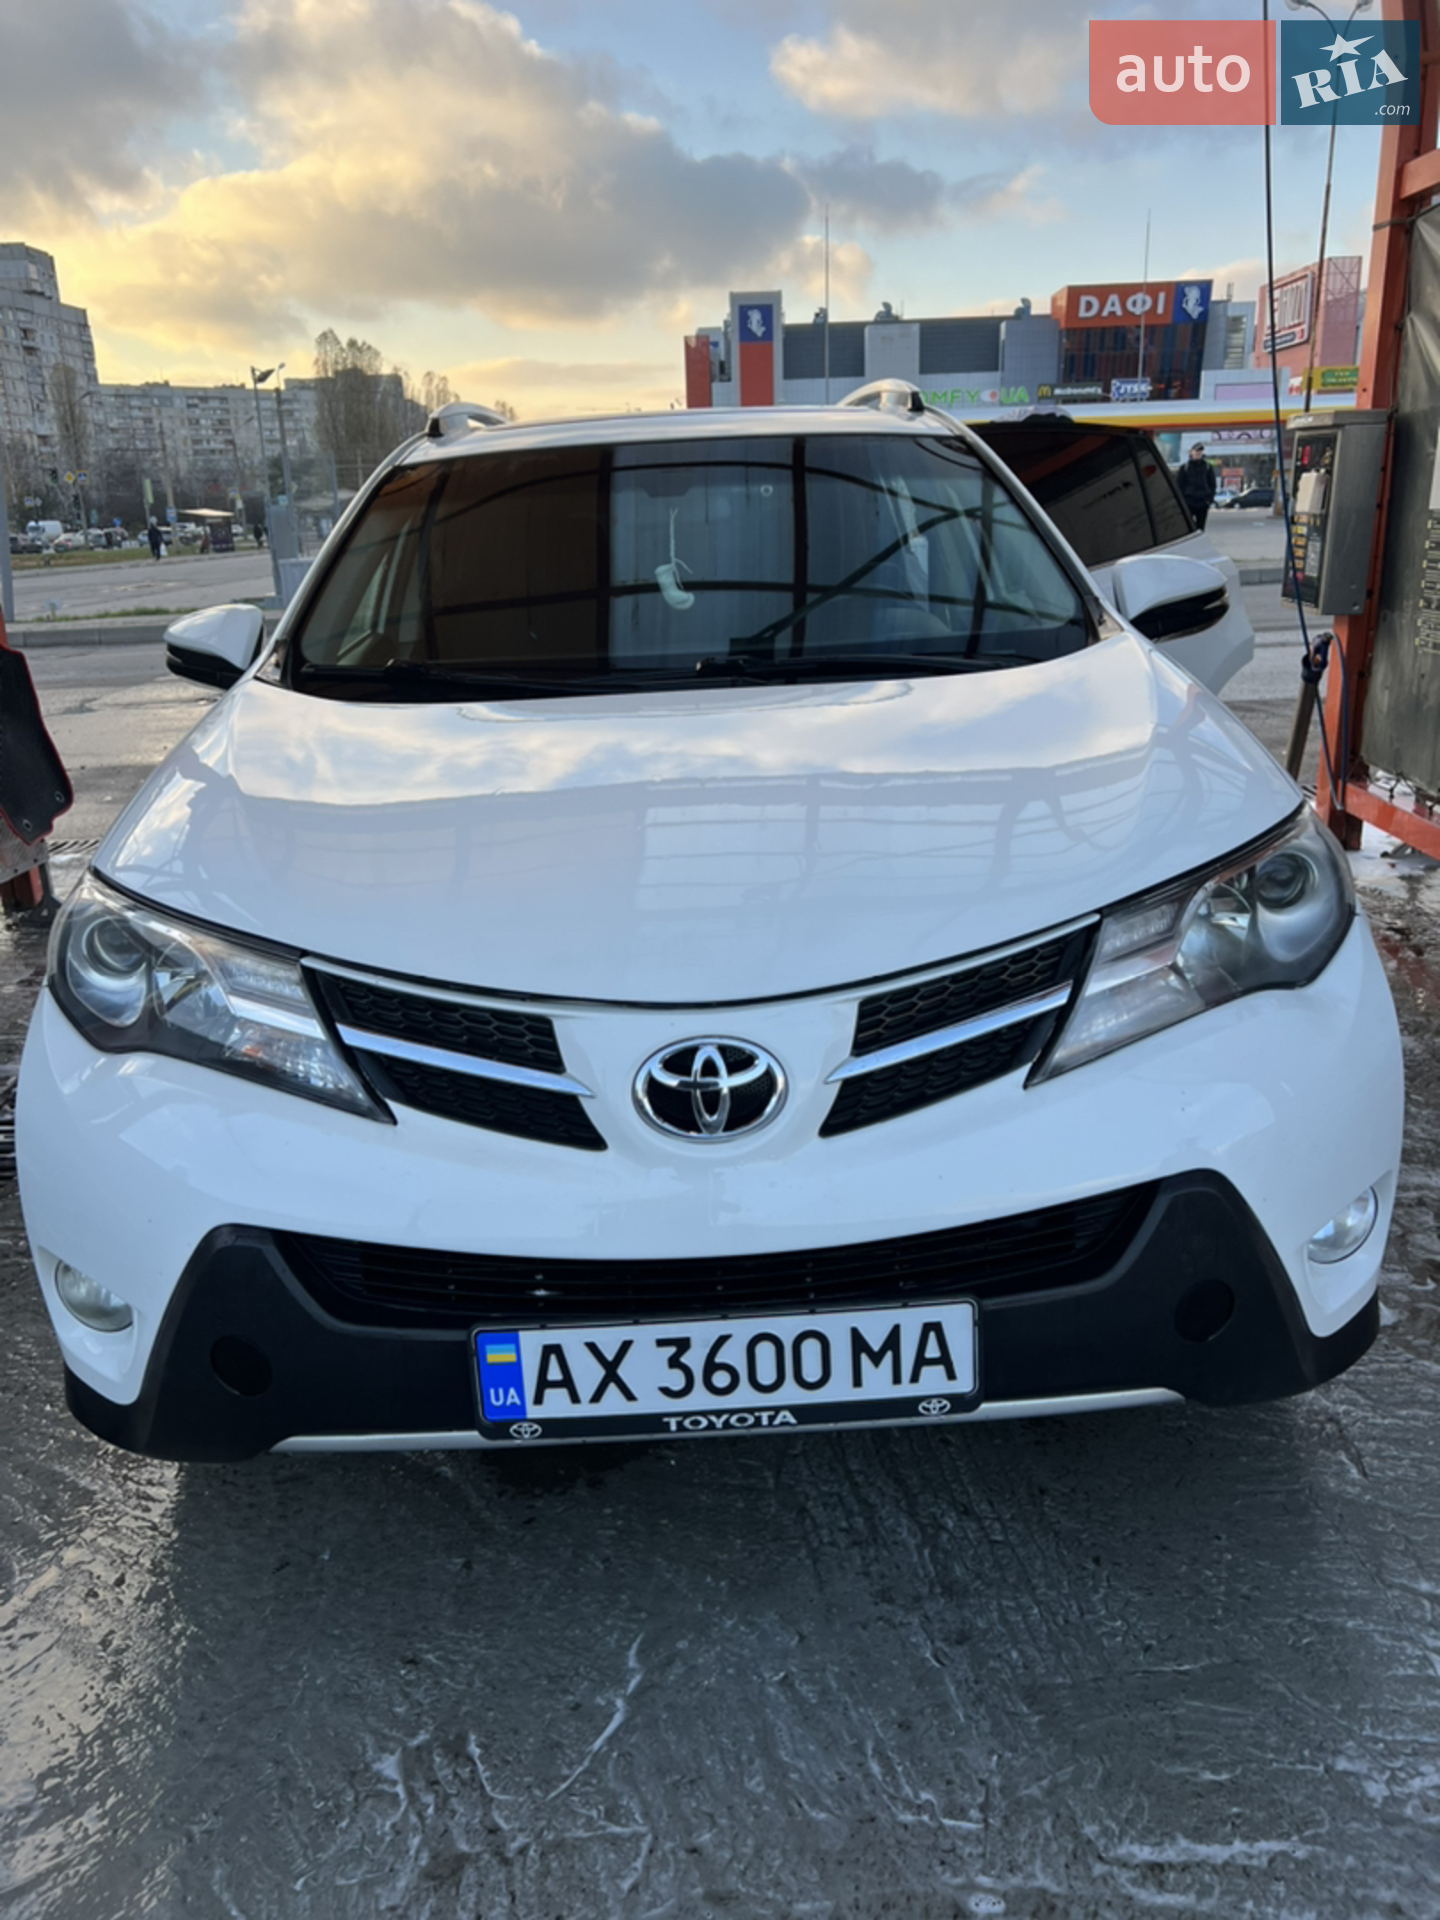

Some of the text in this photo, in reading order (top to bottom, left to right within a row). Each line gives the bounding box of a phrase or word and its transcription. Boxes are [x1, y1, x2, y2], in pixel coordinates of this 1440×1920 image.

[532, 1320, 958, 1406] AX 3600 MA
[489, 1387, 522, 1407] UA
[662, 1409, 799, 1432] TOYOTA
